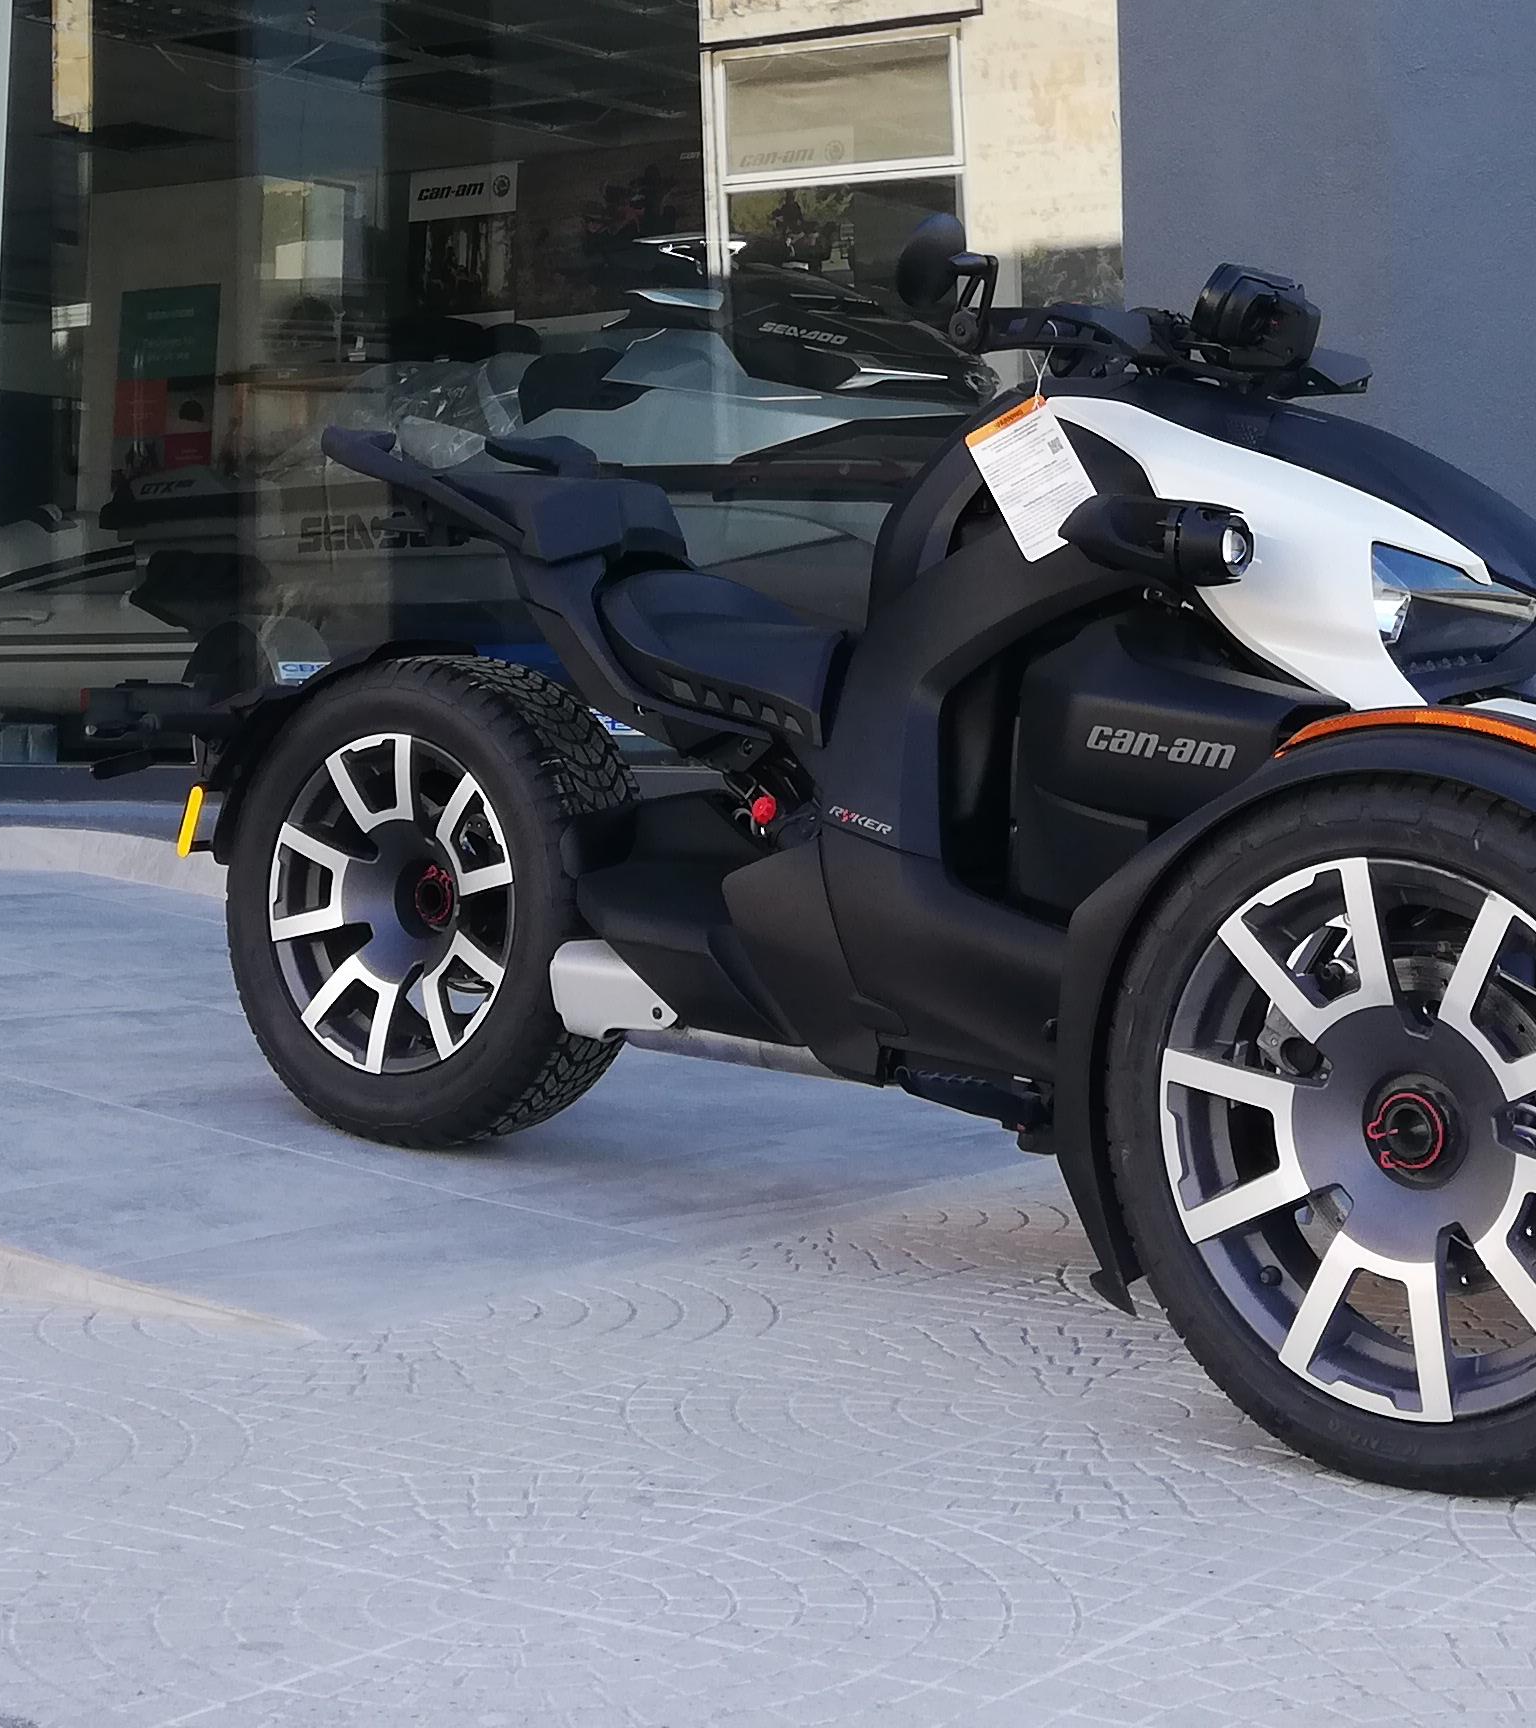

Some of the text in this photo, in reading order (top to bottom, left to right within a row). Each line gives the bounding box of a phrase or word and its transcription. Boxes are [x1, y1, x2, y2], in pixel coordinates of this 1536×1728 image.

[417, 180, 484, 202] can-am
[1086, 724, 1237, 770] can-am
[828, 805, 893, 835] RYKER
